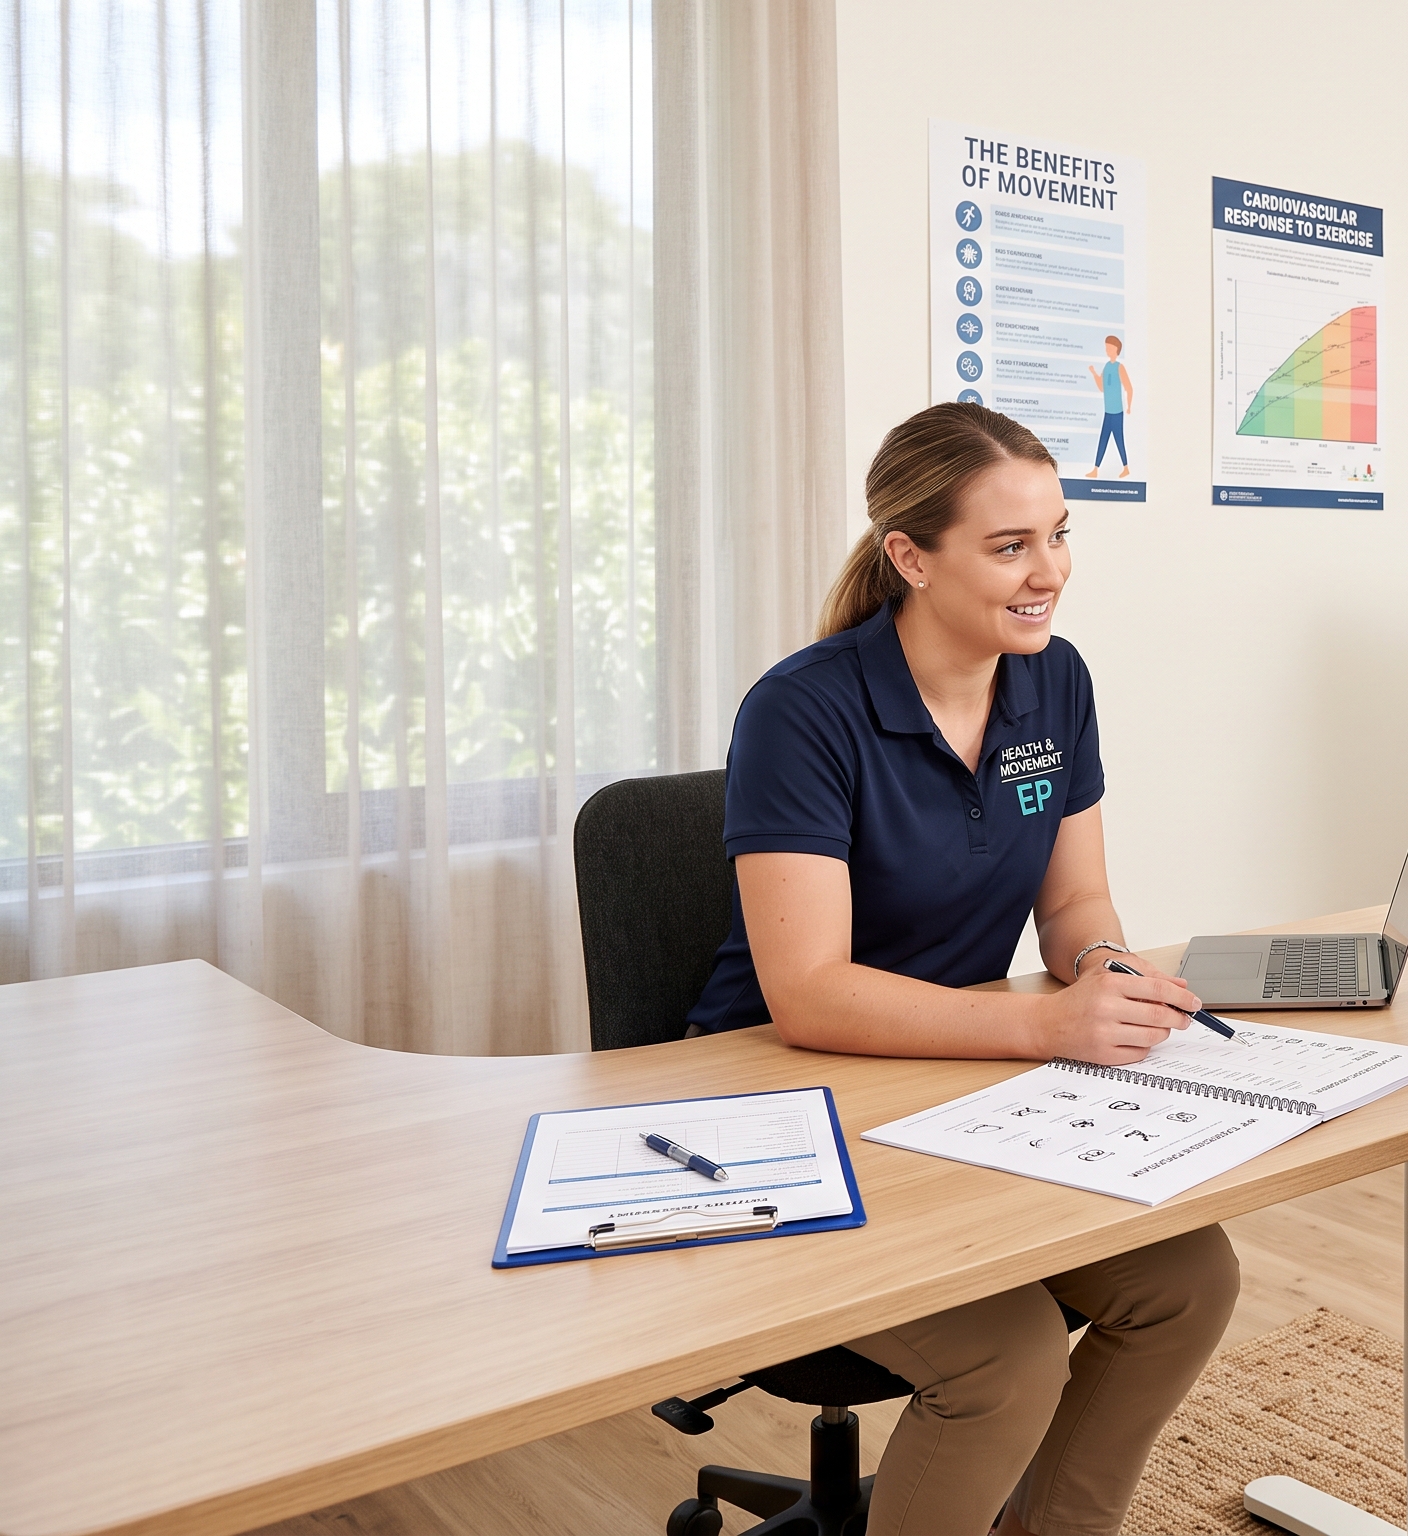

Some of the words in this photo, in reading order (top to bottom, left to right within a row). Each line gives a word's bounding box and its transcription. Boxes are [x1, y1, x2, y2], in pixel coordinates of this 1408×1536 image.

[964, 136, 1009, 166] THE
[1016, 146, 1115, 184] BENEFITS
[962, 164, 991, 190] OF
[998, 170, 1118, 211] MOVEMENT
[1242, 190, 1358, 226] CARDIOVASCULAR
[1224, 207, 1294, 235] RESPONSE
[1295, 220, 1313, 238] TO
[1316, 223, 1374, 249] EXERCISE
[1000, 751, 1063, 778] MOVEMENT
[1001, 741, 1043, 762] HEALTH
[1045, 738, 1055, 752] &
[1016, 779, 1053, 816] EP
